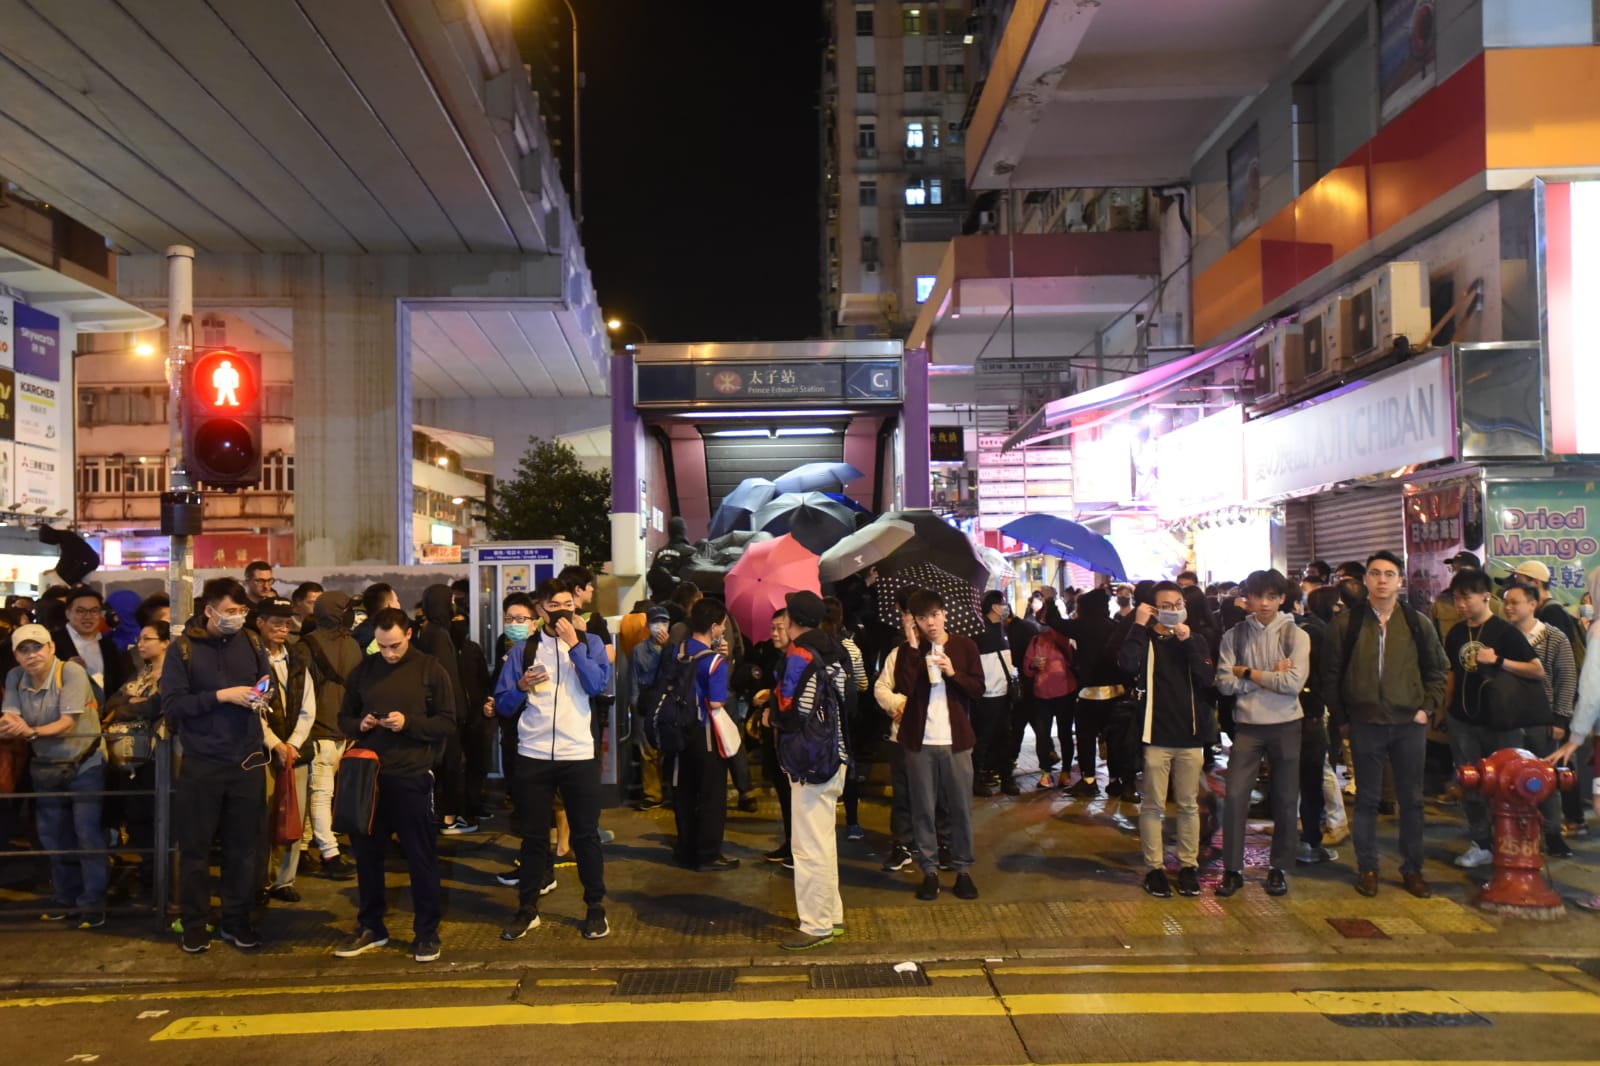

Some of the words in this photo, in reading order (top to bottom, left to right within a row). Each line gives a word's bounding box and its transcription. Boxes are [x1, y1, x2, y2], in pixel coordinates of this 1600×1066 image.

[748, 369, 796, 384] 太子站
[748, 386, 770, 394] Prince
[771, 386, 799, 394] Edward
[799, 385, 826, 394] Station
[1503, 506, 1586, 530] Dried
[1493, 534, 1597, 559] Mango
